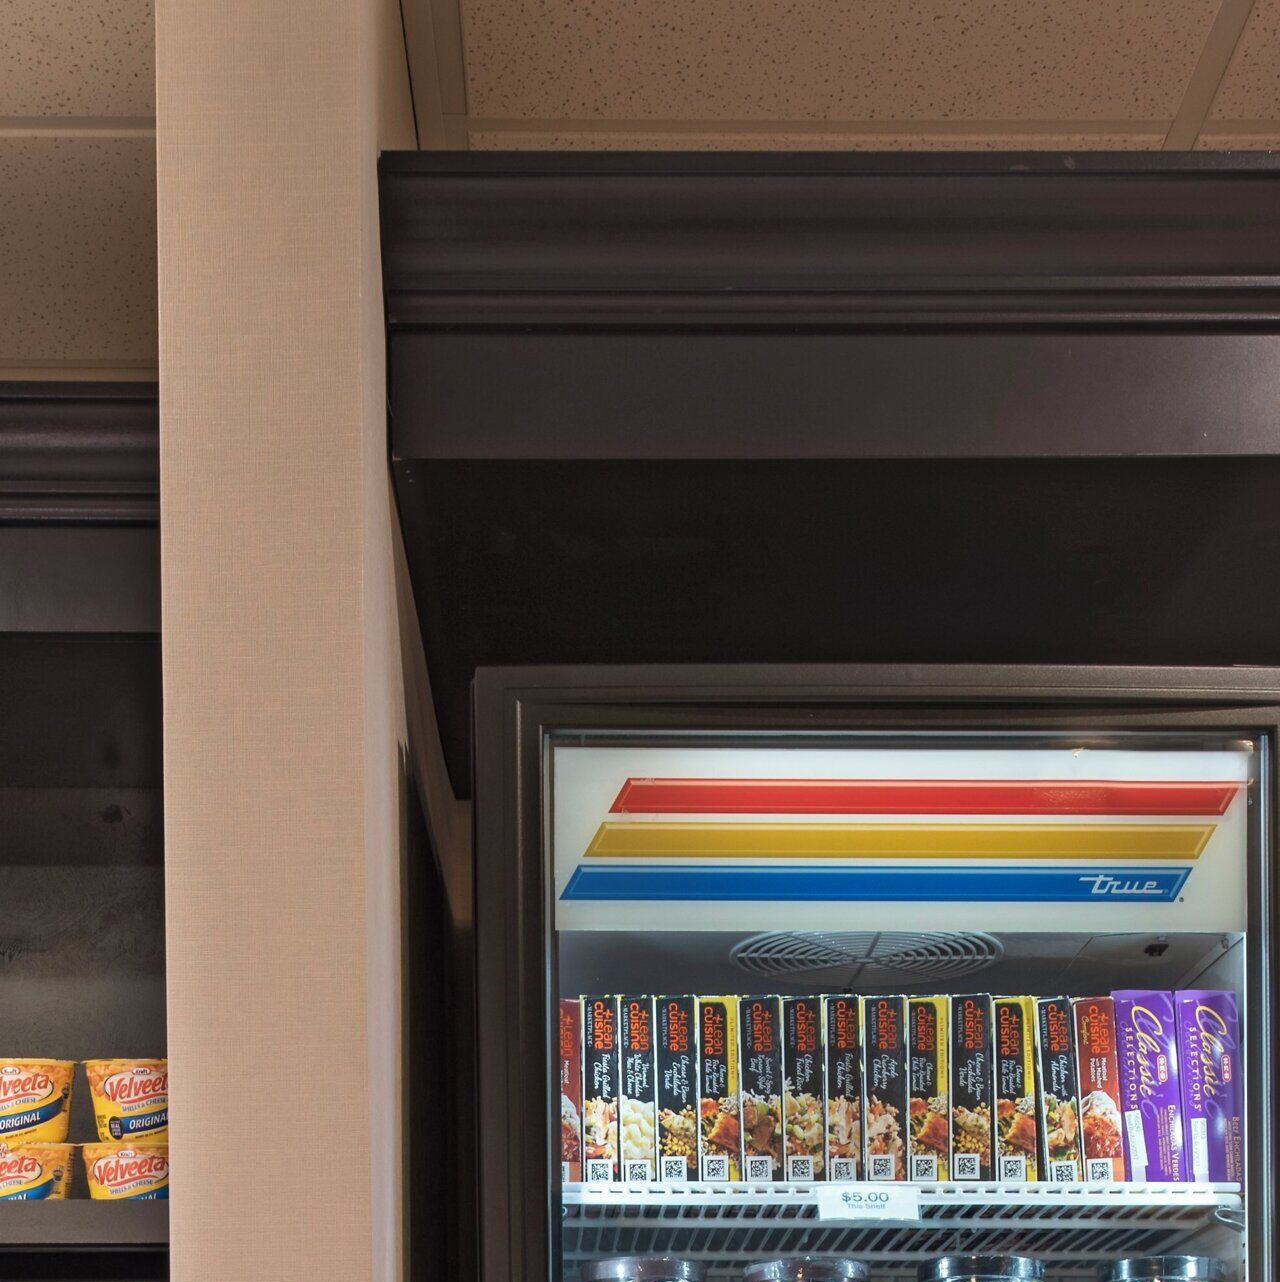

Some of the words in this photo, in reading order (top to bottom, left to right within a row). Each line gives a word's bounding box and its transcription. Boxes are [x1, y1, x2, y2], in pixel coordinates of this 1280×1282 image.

[1079, 876, 1164, 895] true
[1126, 1027, 1138, 1110] SELECTIONS
[0, 1112, 41, 1130] ORIGINAL
[842, 1191, 889, 1203] $5.00
